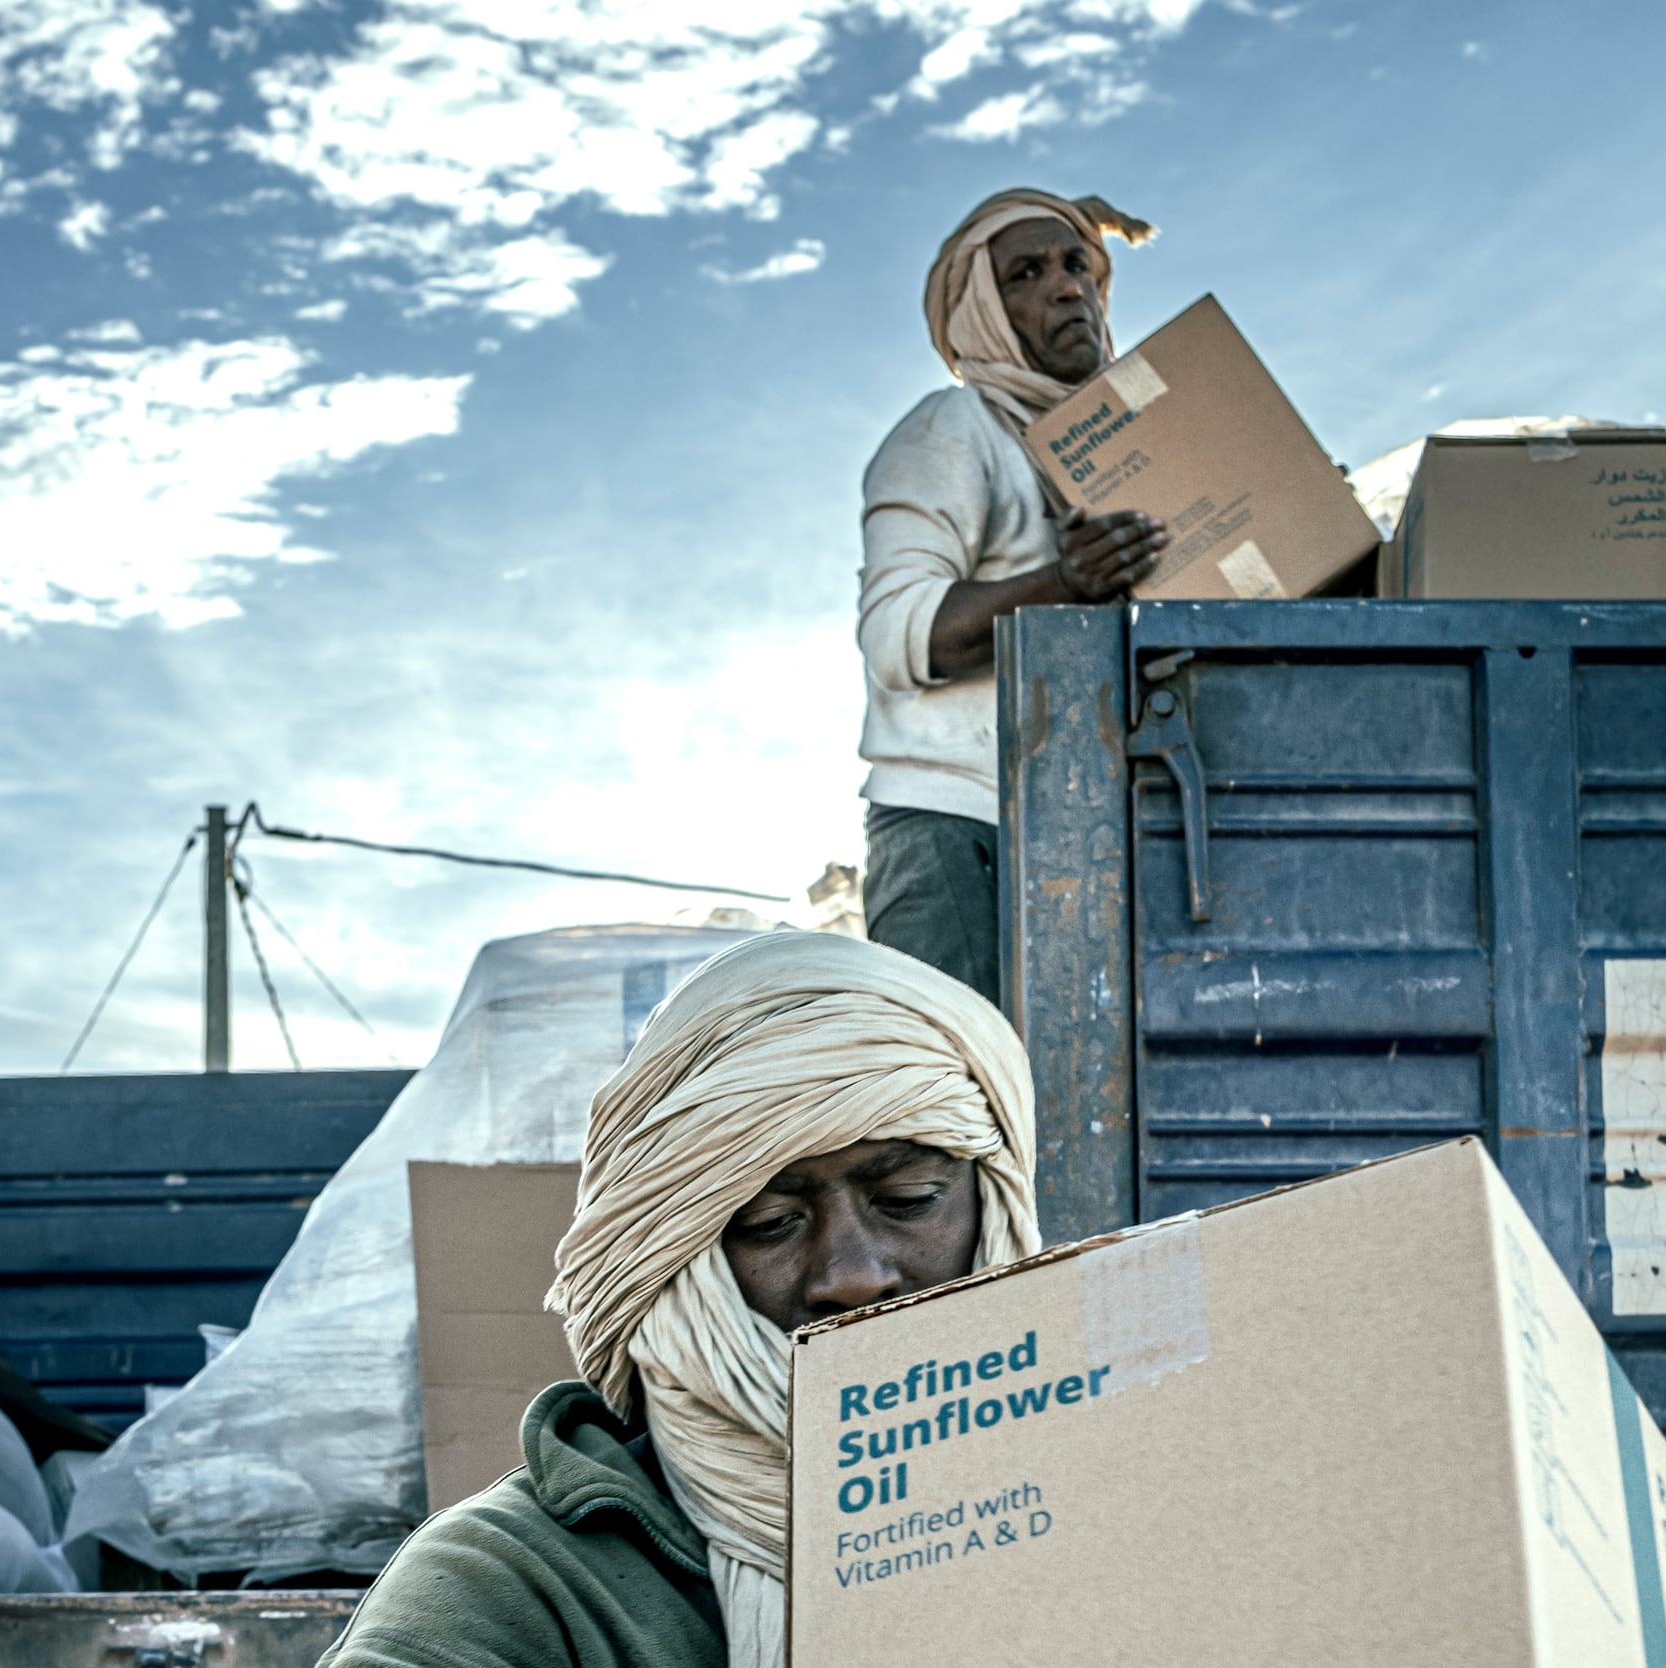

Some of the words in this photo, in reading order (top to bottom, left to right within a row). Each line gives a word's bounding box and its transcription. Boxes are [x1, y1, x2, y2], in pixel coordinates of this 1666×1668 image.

[1049, 402, 1113, 455] Refined
[1070, 459, 1097, 484] Oil
[1589, 467, 1627, 485] دوار
[1607, 488, 1666, 506] الشمس
[1615, 507, 1666, 526] المكرر
[840, 1330, 1036, 1422] Refined
[838, 1365, 1110, 1468] Sunflower
[838, 1462, 907, 1513] Oil
[837, 1500, 964, 1558] Fortified
[974, 1482, 1041, 1519] with
[835, 1541, 953, 1588] Vitamin
[963, 1529, 986, 1556] A
[994, 1520, 1018, 1546] &
[1029, 1510, 1052, 1537] D
